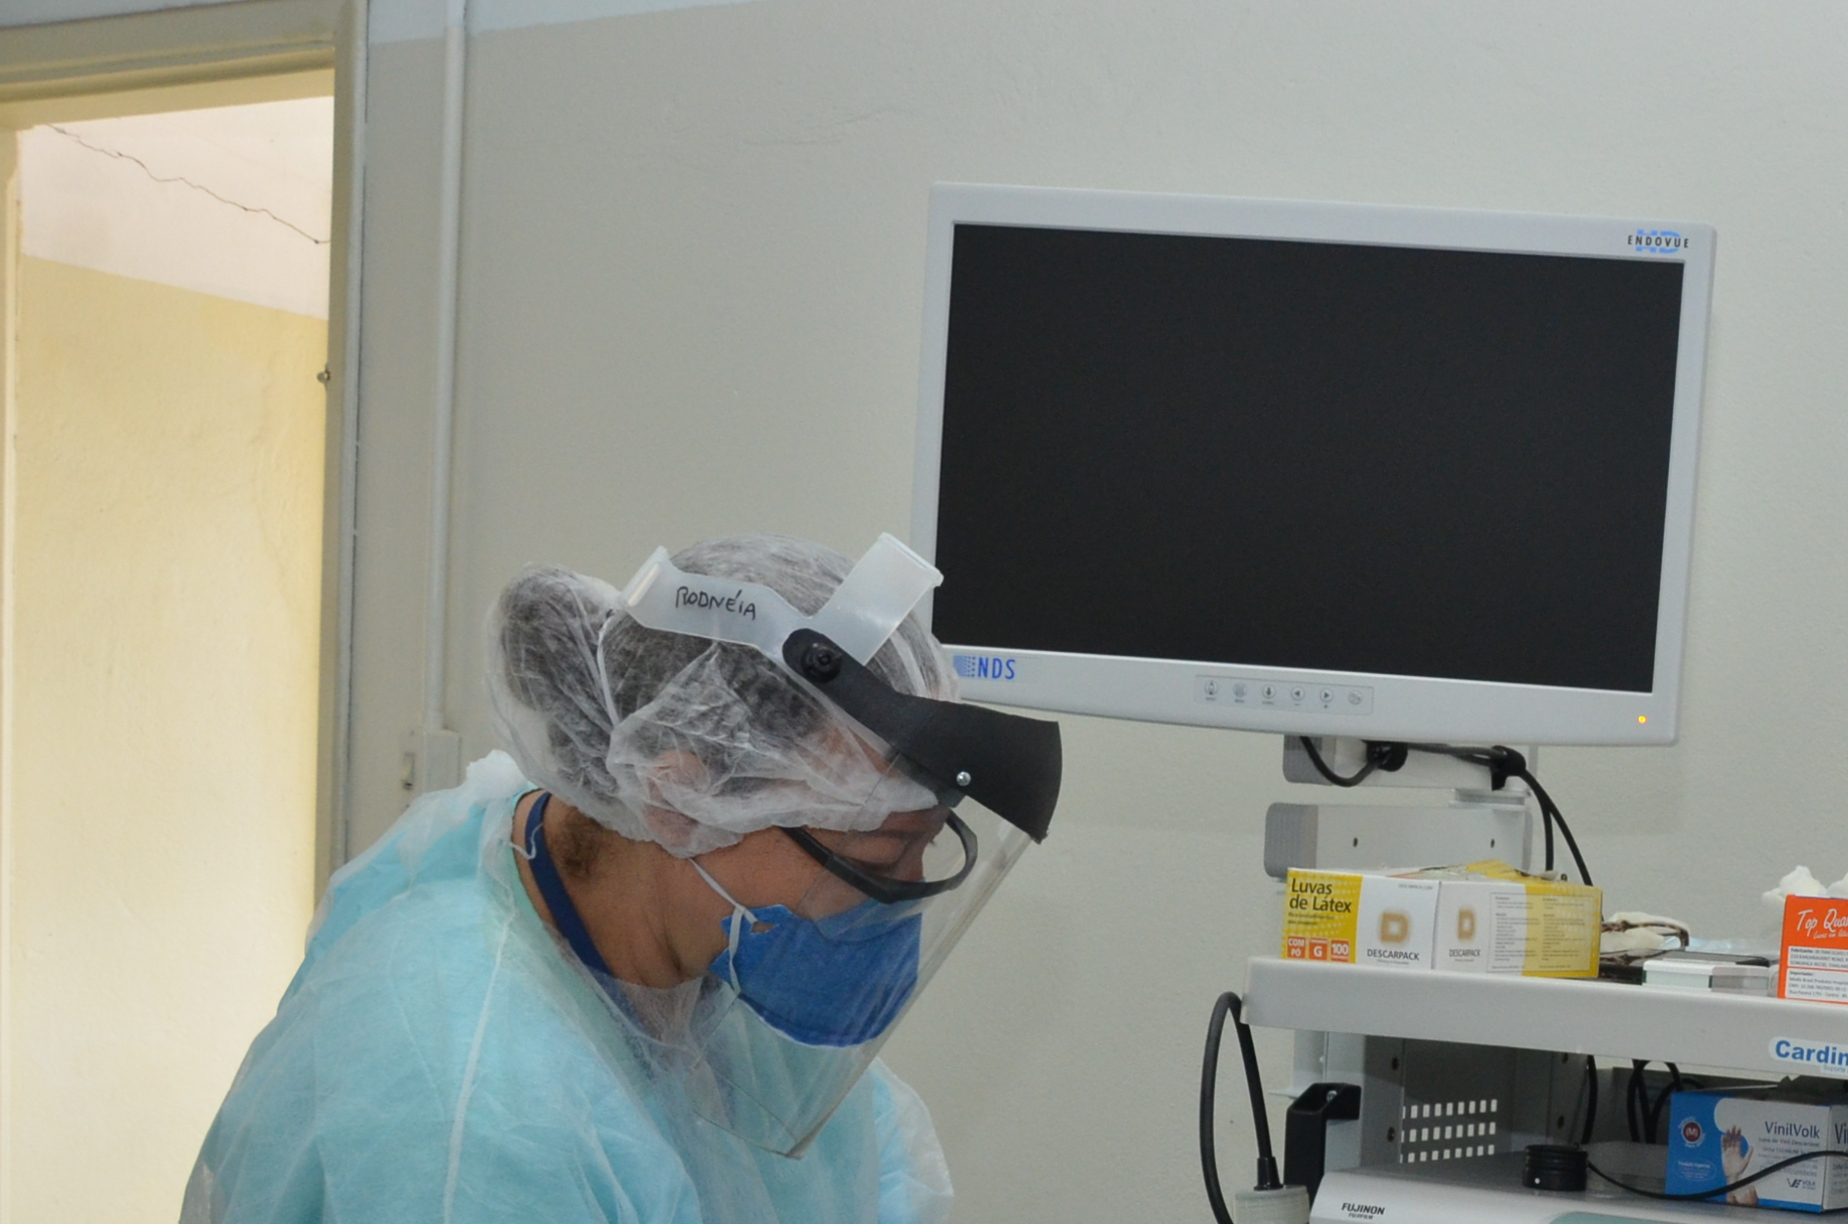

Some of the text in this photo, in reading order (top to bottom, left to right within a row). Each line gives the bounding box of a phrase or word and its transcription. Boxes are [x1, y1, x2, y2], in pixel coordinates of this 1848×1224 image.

[1627, 235, 1689, 248] ENDOVUE
[675, 586, 756, 621] RODNÉIA
[977, 656, 1016, 680] NDS
[1291, 878, 1333, 895] Luvas
[1289, 894, 1352, 913] de Látex
[1797, 909, 1818, 937] Top
[1288, 938, 1305, 947] COM
[1332, 943, 1349, 955] 100
[1313, 945, 1323, 957] G
[1367, 948, 1420, 961] DESCARPACK
[1449, 948, 1481, 958] DESCARPACK
[1765, 1121, 1820, 1139] VinilVolk
[1341, 1202, 1385, 1215] FUJINON
